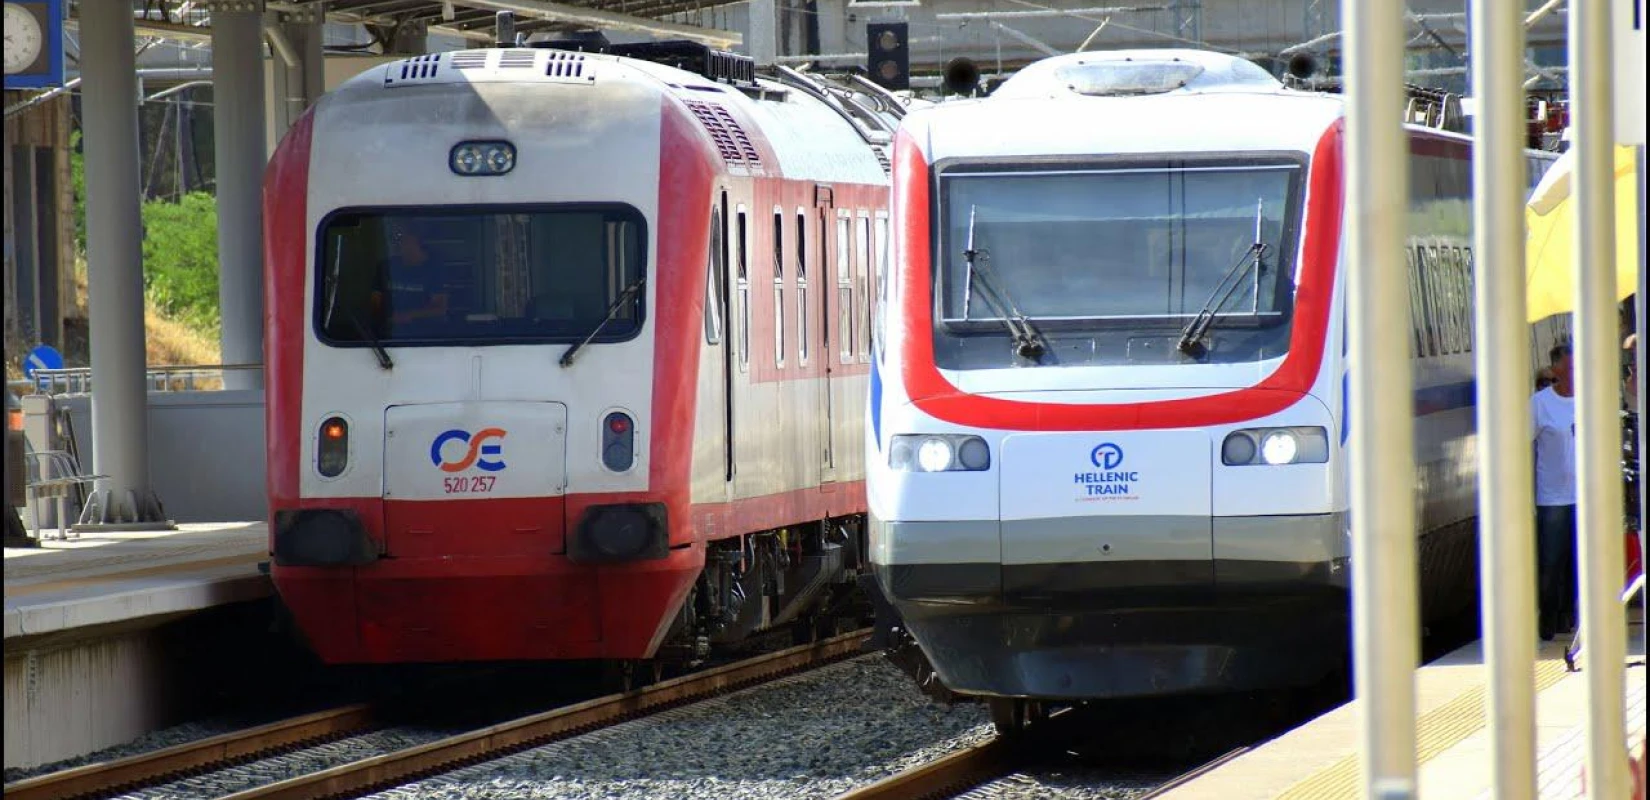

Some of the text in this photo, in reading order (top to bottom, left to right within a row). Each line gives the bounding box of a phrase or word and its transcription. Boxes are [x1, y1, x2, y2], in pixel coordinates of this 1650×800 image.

[1074, 471, 1139, 483] HELLENIC
[444, 475, 496, 494] 520 257
[1085, 484, 1129, 495] TRAIN
